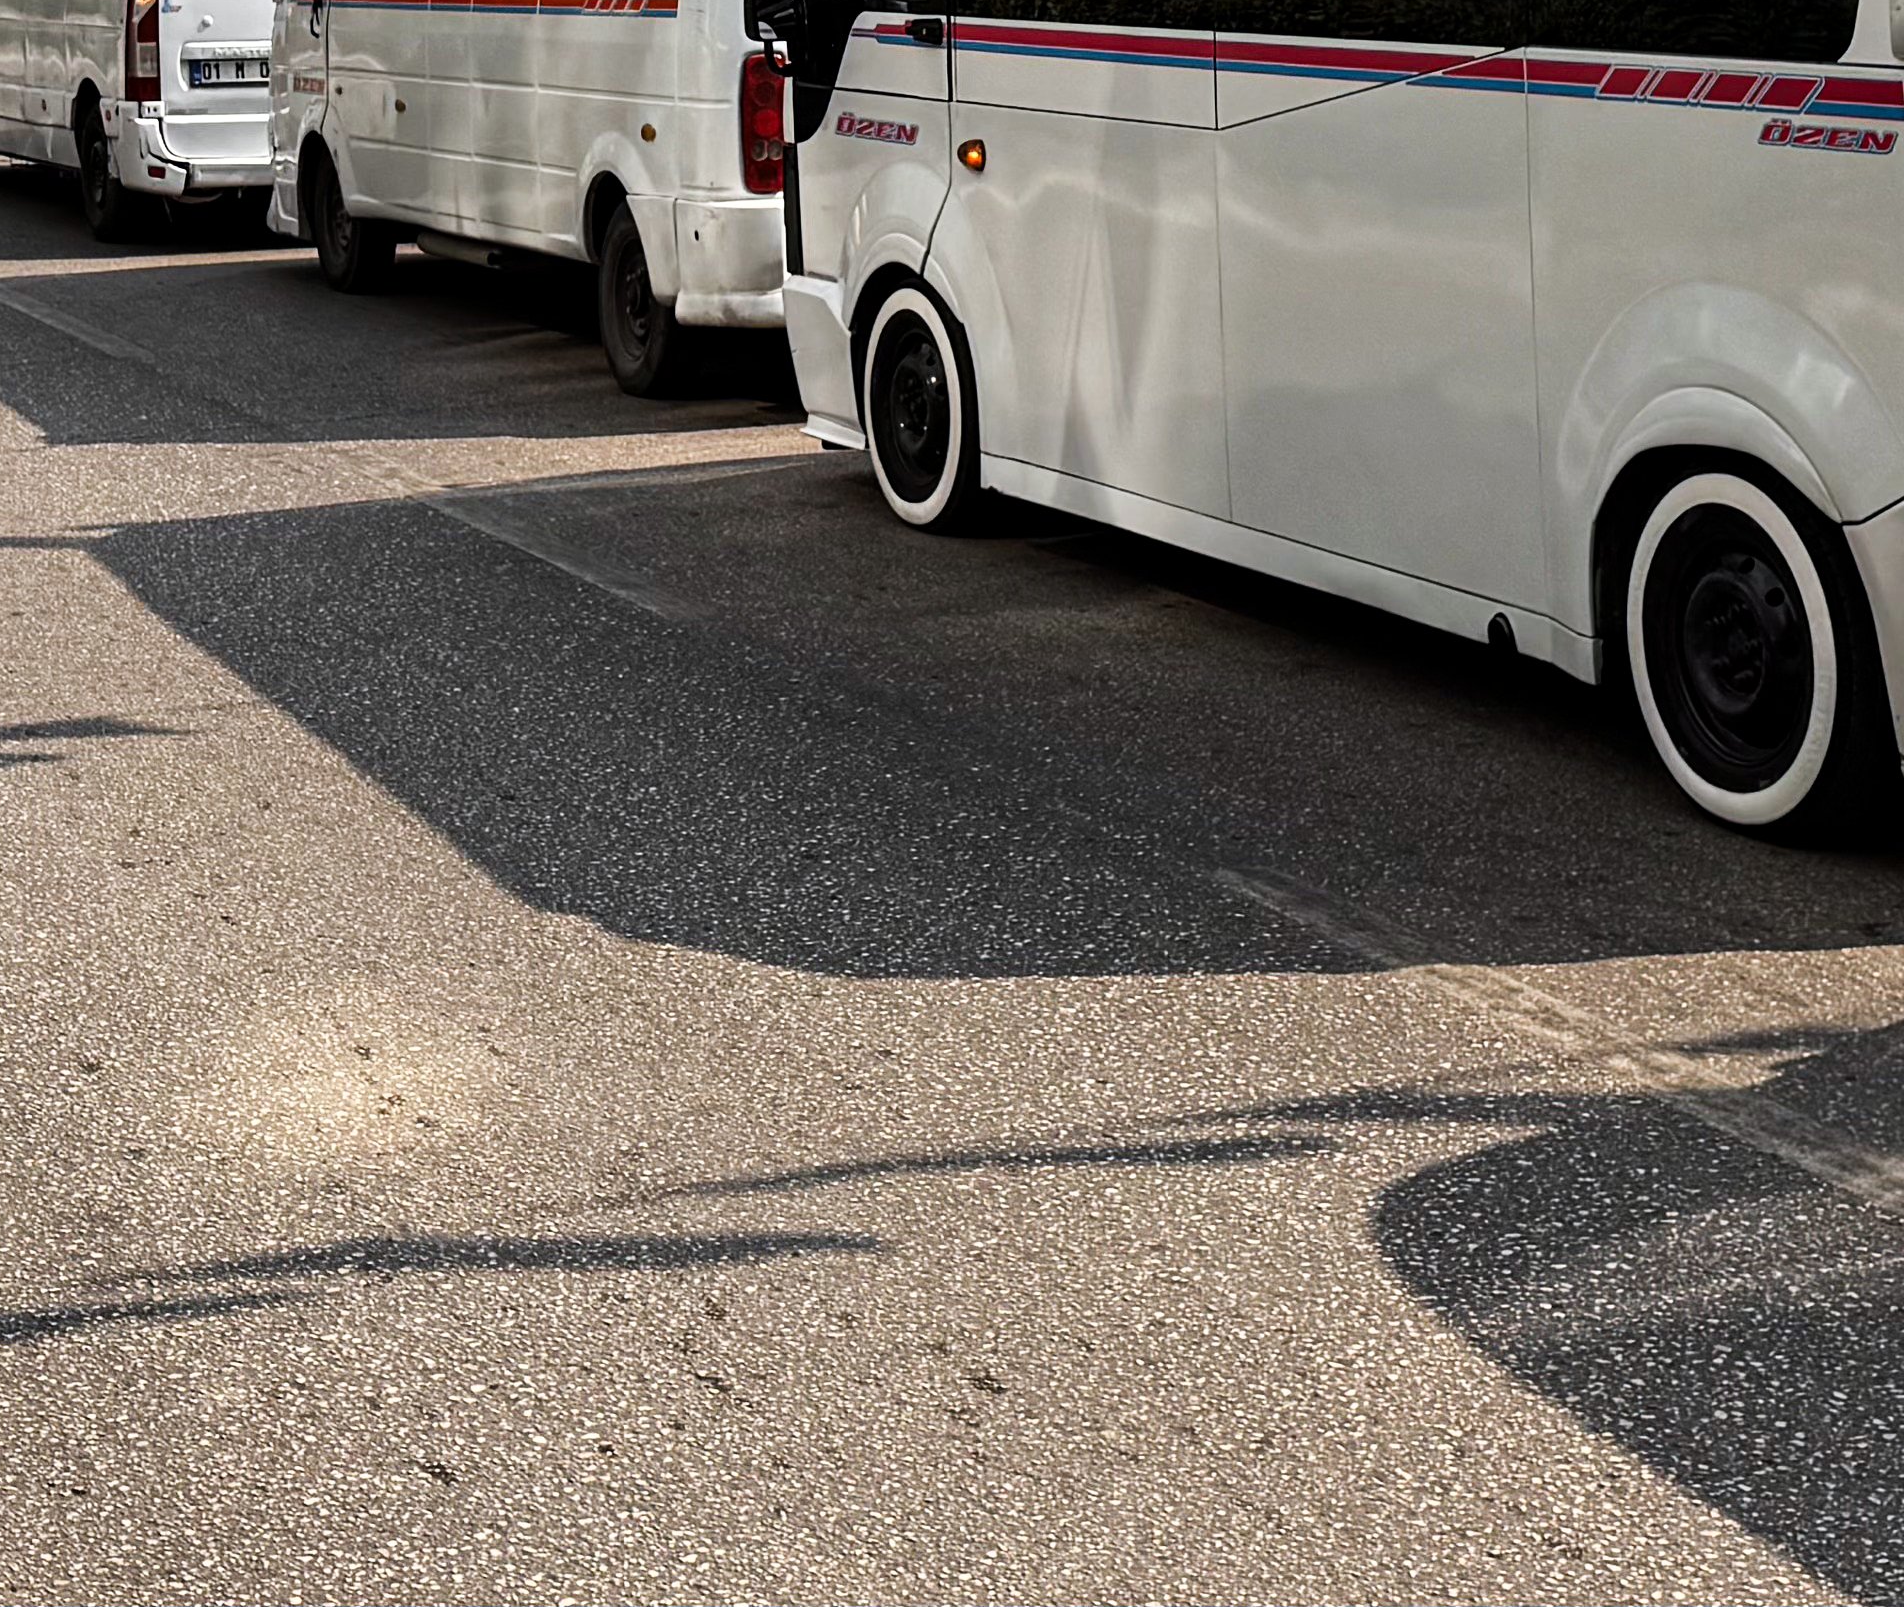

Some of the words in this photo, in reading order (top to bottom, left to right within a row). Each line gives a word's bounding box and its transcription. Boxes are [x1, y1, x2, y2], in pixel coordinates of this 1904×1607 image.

[202, 61, 221, 80] 01
[235, 61, 245, 79] M
[1758, 117, 1899, 155] ÖZEN
